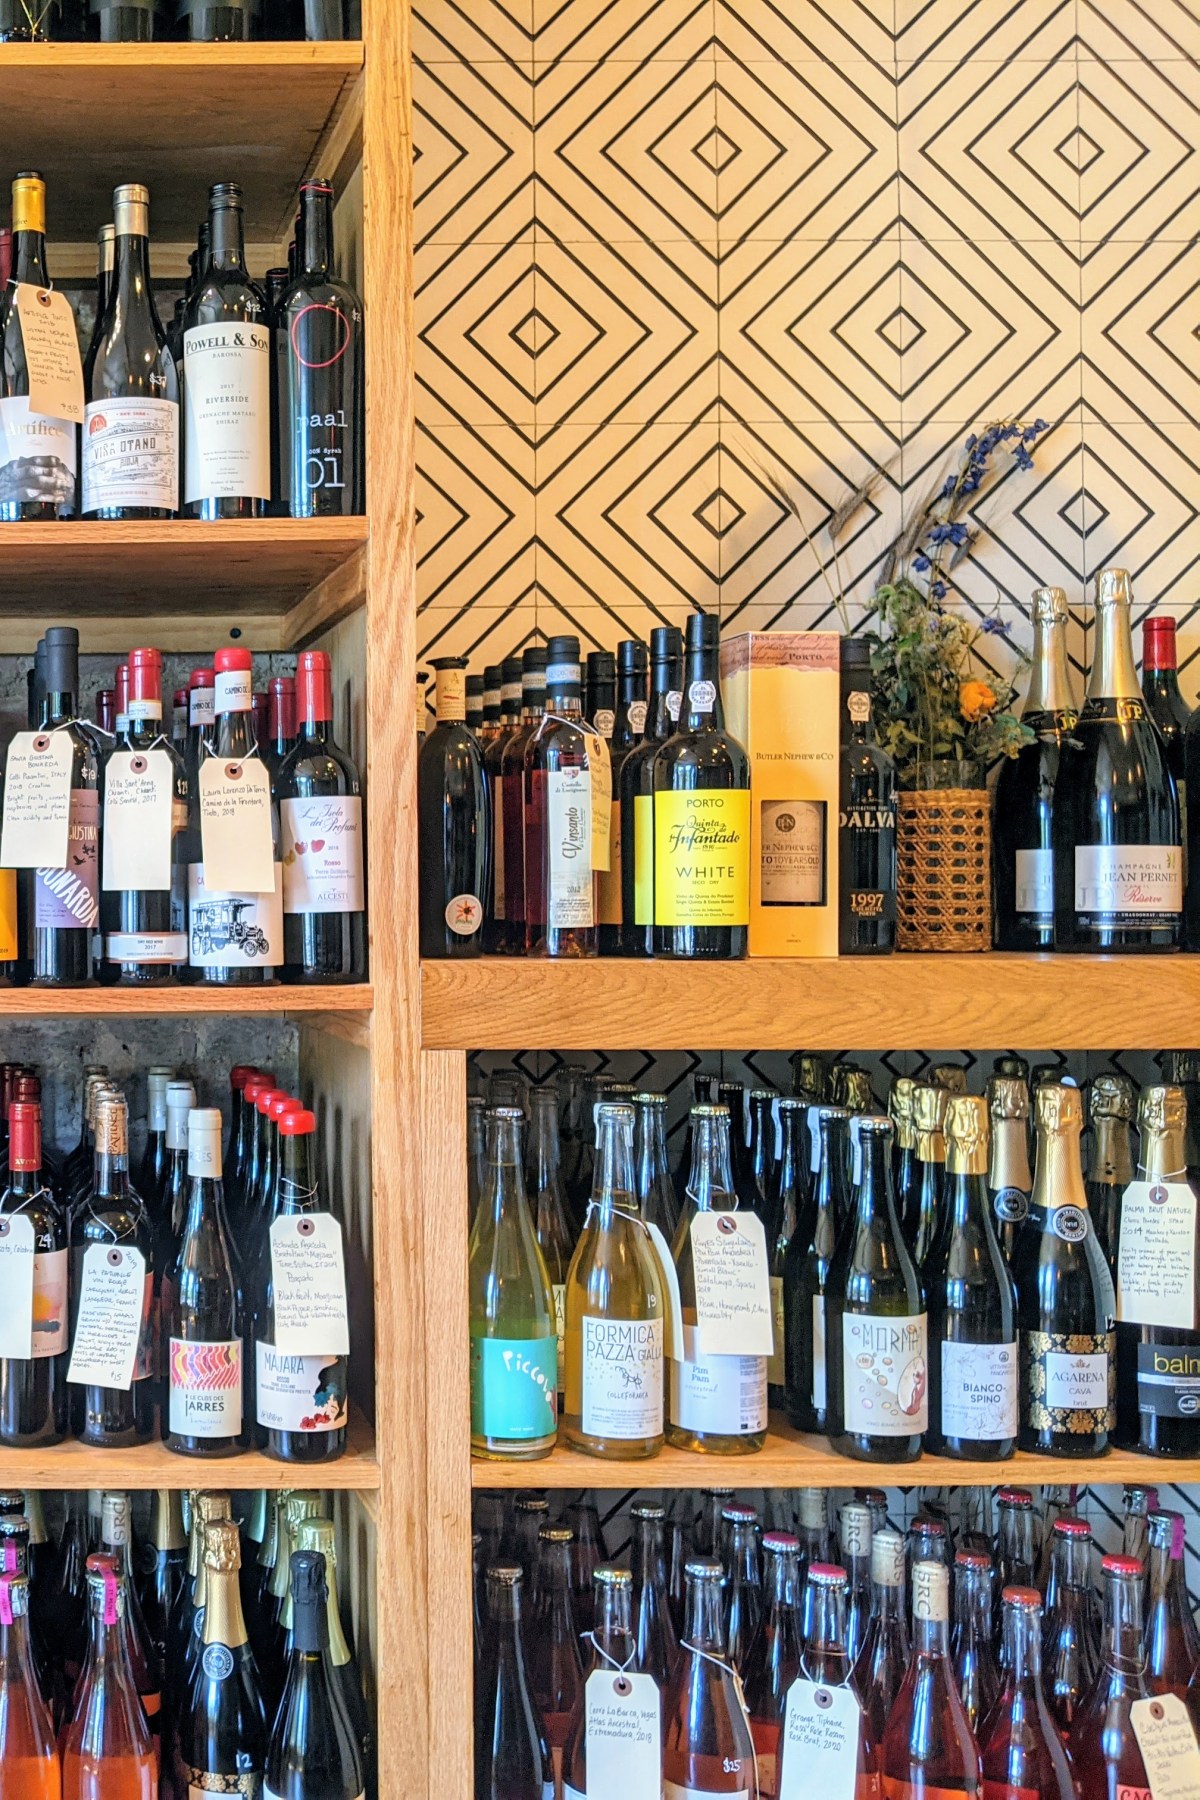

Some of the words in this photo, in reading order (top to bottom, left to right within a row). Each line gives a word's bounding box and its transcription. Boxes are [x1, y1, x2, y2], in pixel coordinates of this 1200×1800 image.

[185, 335, 230, 353] POWELL
[234, 332, 247, 347] &
[205, 395, 250, 405] RIVERSIDE
[215, 419, 239, 427] SHIRAZ
[296, 410, 349, 433] paal
[323, 447, 343, 455] Syrah
[755, 752, 783, 761] BUTLER
[783, 752, 815, 761] NEPHEW
[27, 761, 59, 769] BONARDA
[50, 771, 67, 779] ITALY
[202, 788, 221, 798] Laura
[222, 787, 246, 796] Lorenzo
[201, 798, 222, 808] Camino
[686, 798, 725, 808] PORTO
[319, 803, 344, 819] Isola
[321, 817, 358, 837] Profumi
[685, 815, 720, 831] Quinta
[561, 806, 583, 859] Vinsanto
[670, 824, 741, 853] Infantado
[323, 860, 342, 868] Rosso
[676, 866, 736, 879] WHITE
[1104, 872, 1137, 883] JEAN
[1140, 871, 1179, 883] PERNET
[850, 893, 885, 908] 1997
[1124, 1204, 1146, 1213] BALMA
[1148, 1205, 1164, 1213] BRUT
[1166, 1206, 1192, 1215] NATURE
[1122, 1223, 1143, 1236] 2014
[37, 1234, 52, 1250] 24
[586, 1322, 655, 1344] FORMICA
[586, 1340, 636, 1362] PAZZA
[264, 1352, 305, 1375] MAJARA
[502, 1350, 554, 1402] Piccolo
[692, 1365, 709, 1375] Pim
[691, 1373, 710, 1383] Pam
[1051, 1371, 1106, 1383] AGARENA
[1068, 1387, 1092, 1396] CAVA
[970, 1394, 1002, 1404] SPINO
[1072, 1399, 1089, 1407] brut
[636, 1732, 653, 1744] 2018
[823, 1740, 842, 1752] 2020
[235, 1753, 253, 1769] 12
[723, 1757, 742, 1773] $25
